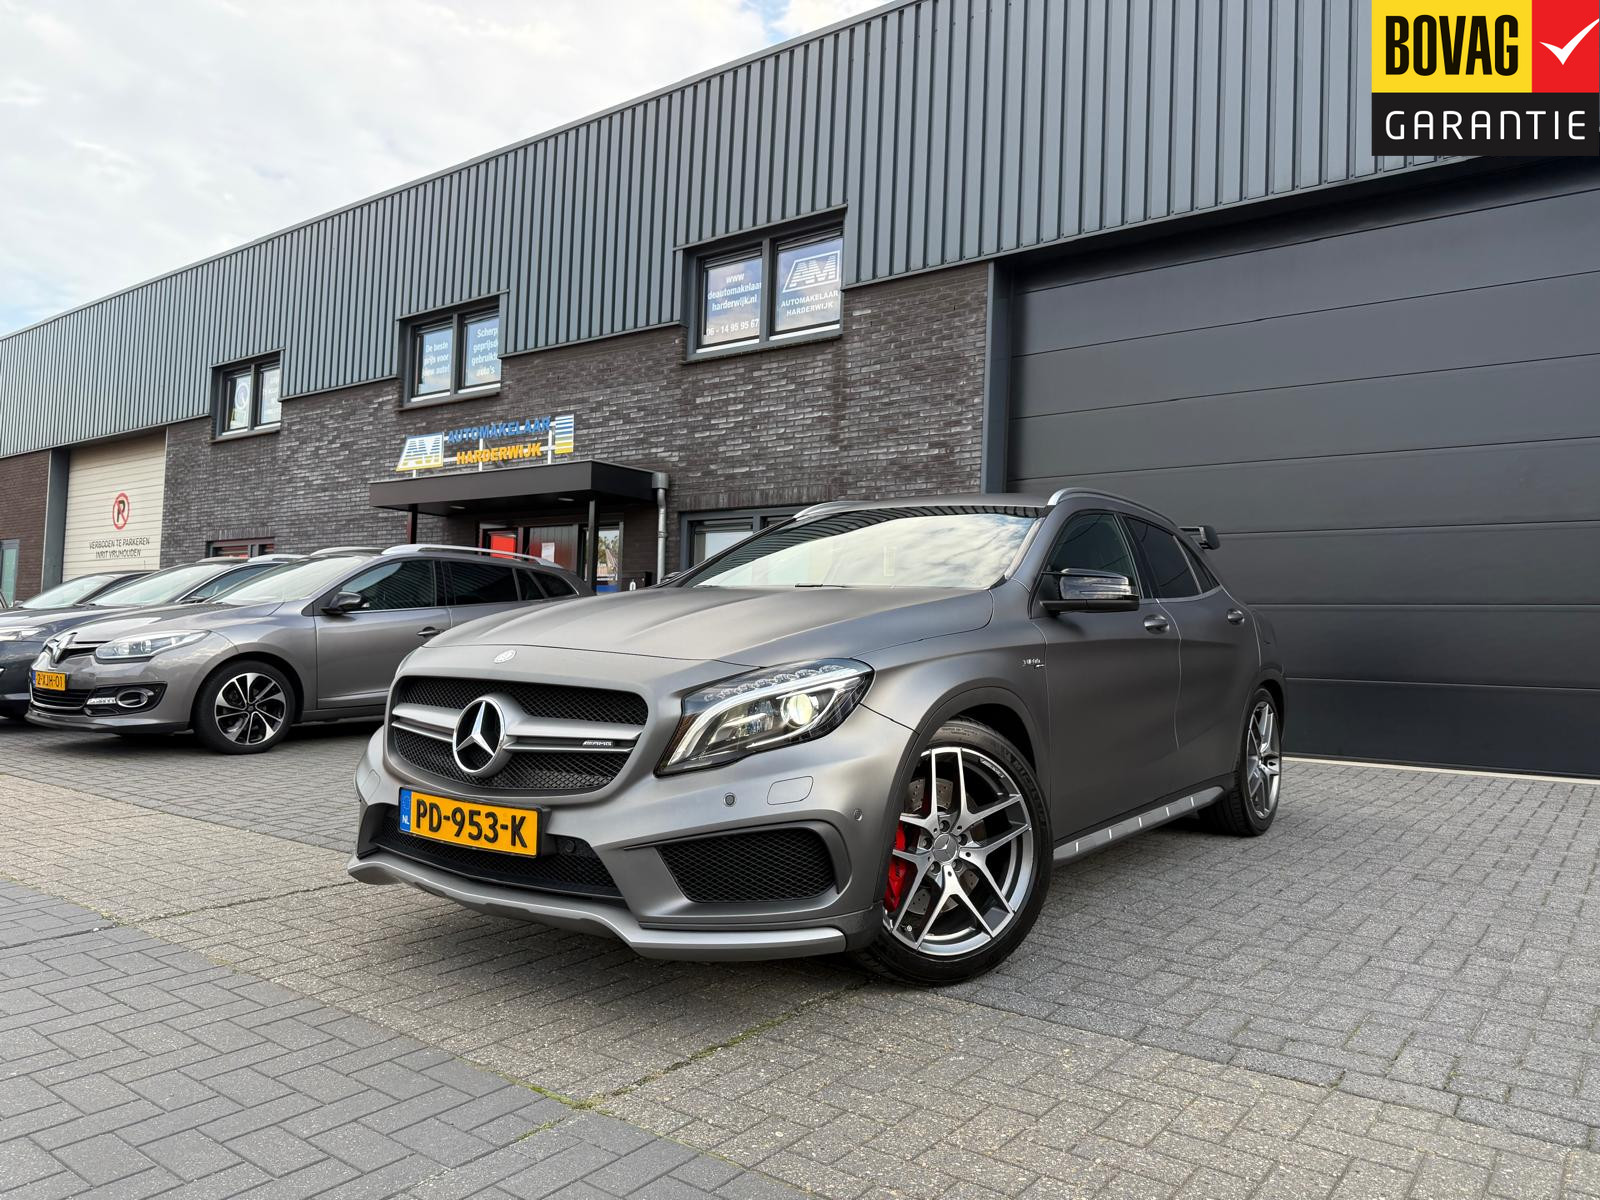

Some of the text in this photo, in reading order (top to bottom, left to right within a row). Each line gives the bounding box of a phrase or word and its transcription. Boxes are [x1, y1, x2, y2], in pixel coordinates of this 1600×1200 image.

[725, 272, 746, 284] www
[711, 294, 757, 312] harderwijk.nl
[781, 289, 839, 308] AUTOMAKELAAR
[786, 301, 835, 317] HARDERWIJK
[476, 327, 499, 338] Scherp
[706, 327, 716, 337] 06
[720, 325, 729, 335] 14
[730, 323, 740, 333] 95
[740, 321, 750, 331] 95
[750, 319, 760, 329] 67
[447, 415, 552, 444] AUTOMAKELAAR
[456, 442, 542, 465] HARDERWIJK
[88, 537, 151, 550] VERBODEN TE PARKEREN
[402, 815, 410, 825] NL
[416, 799, 528, 848] PD-953-K
